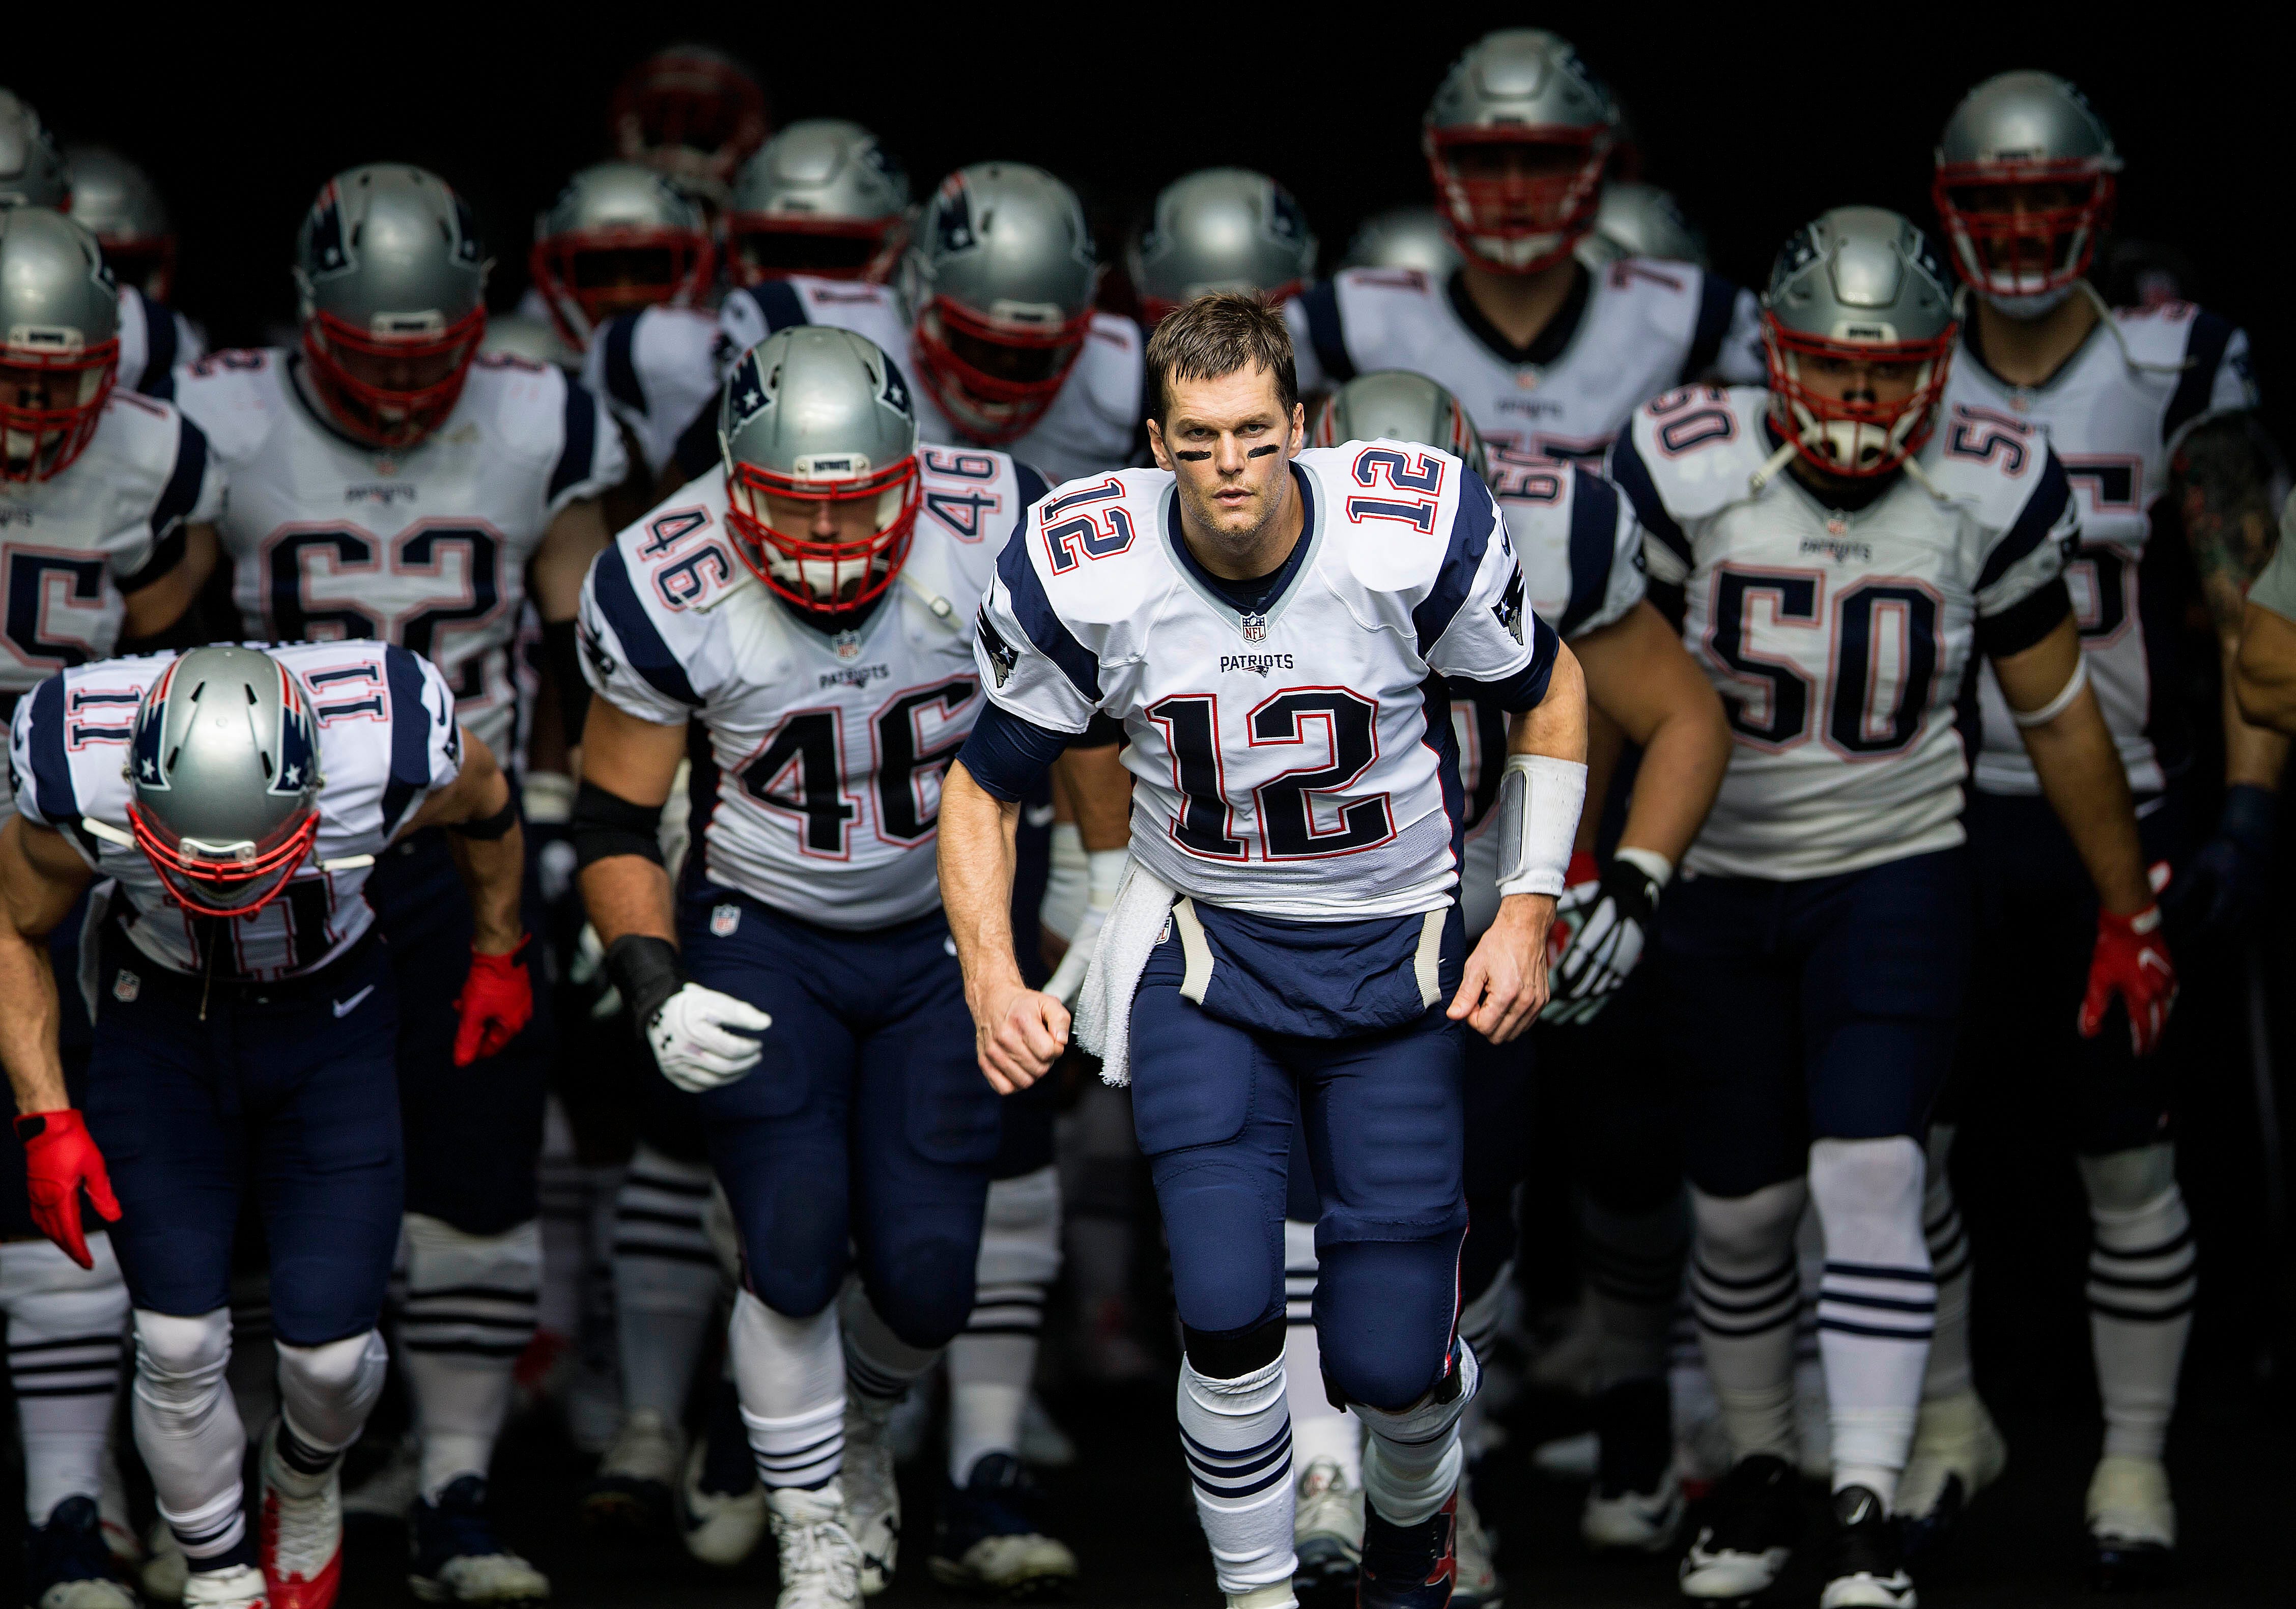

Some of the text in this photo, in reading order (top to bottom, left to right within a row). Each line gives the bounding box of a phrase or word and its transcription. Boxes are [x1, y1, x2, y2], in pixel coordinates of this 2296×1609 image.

[918, 446, 1002, 544] 46
[1040, 477, 1135, 576] 12
[1345, 446, 1445, 535] 12
[636, 502, 735, 613] 46
[1221, 654, 1294, 673] PATRIOTS
[1245, 627, 1264, 640] NFL
[1704, 560, 1946, 764] 50
[66, 685, 147, 752] 11
[301, 660, 388, 729] 11
[731, 672, 982, 861] 46
[1145, 685, 1397, 863] 12
